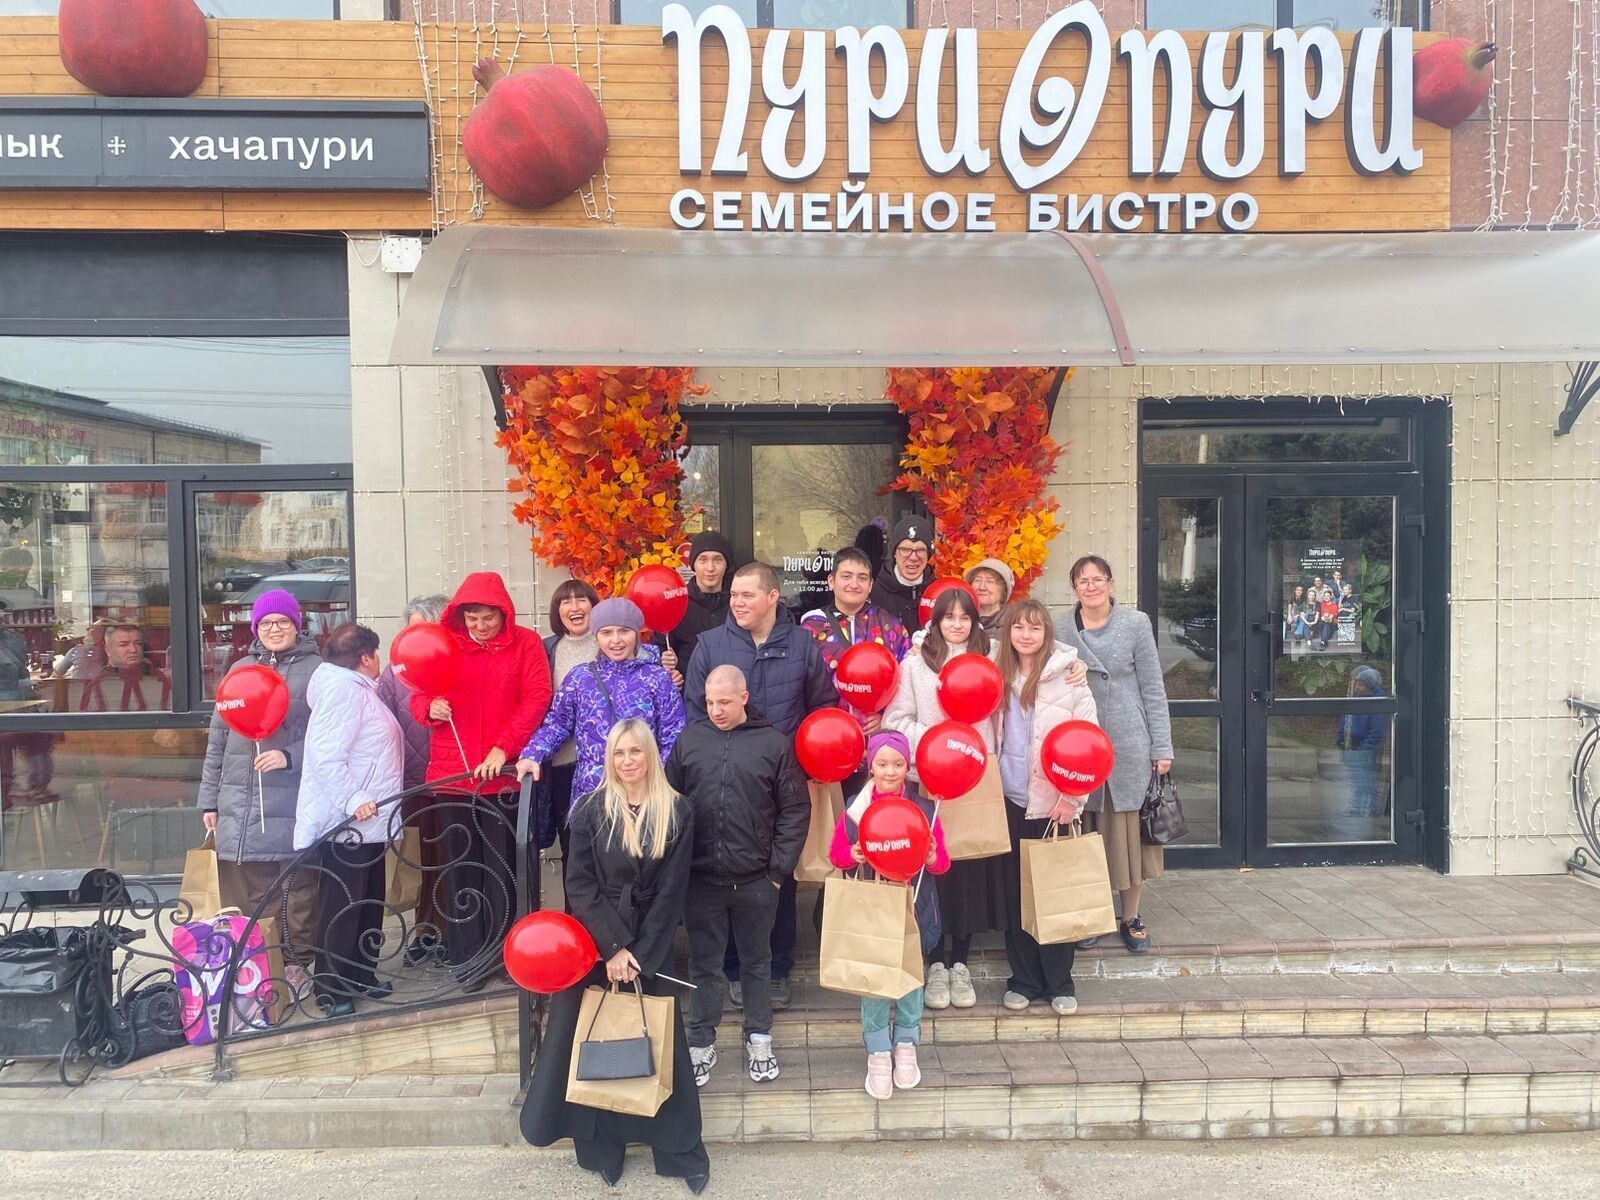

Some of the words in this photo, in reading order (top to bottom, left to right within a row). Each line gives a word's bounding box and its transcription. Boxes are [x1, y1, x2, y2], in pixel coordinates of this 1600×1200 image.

[0, 134, 64, 158] ык
[169, 134, 374, 169] хачапури
[669, 181, 996, 232] СЕМЕЙНОЕ
[1029, 190, 1259, 232] БИСТРО
